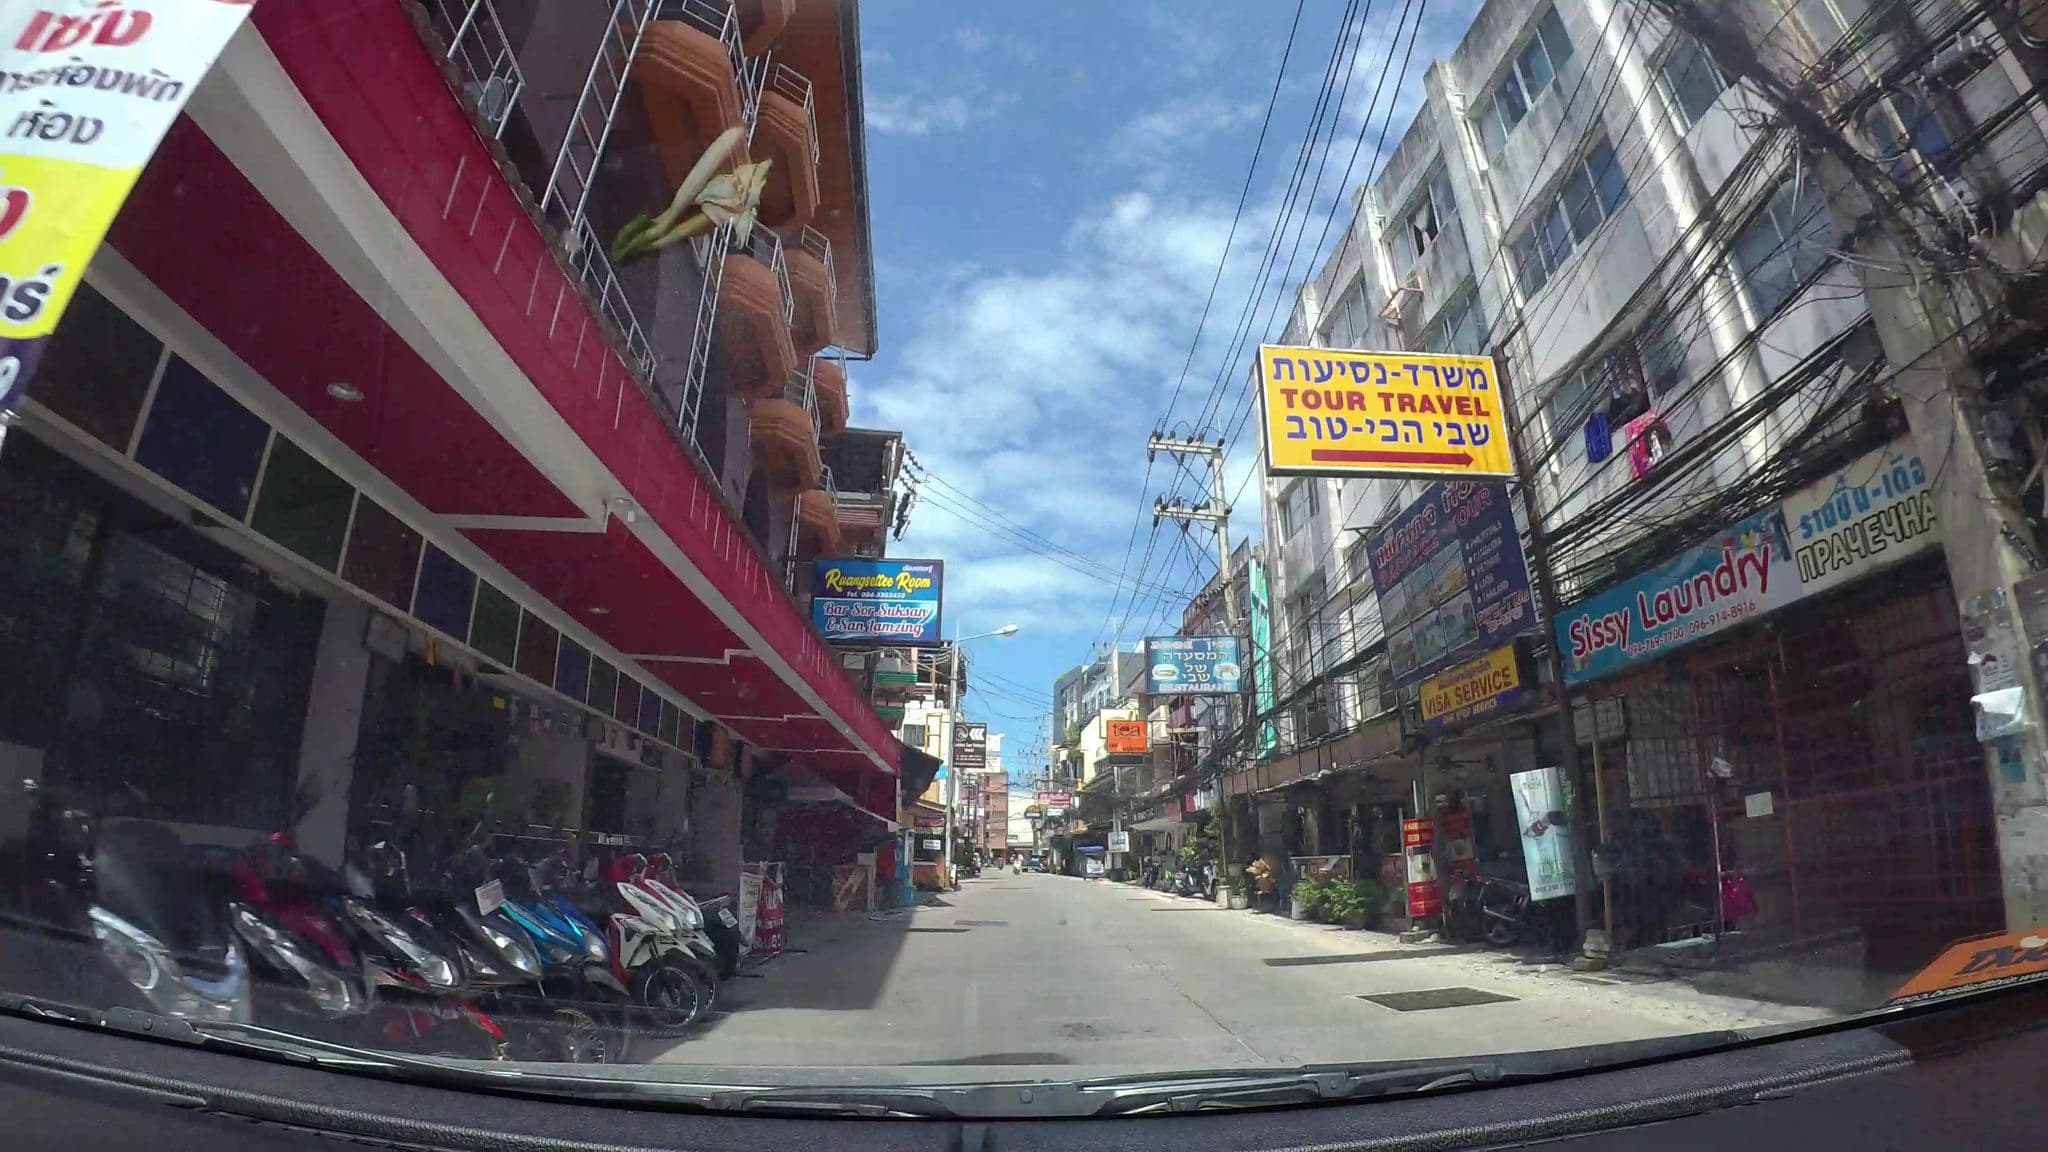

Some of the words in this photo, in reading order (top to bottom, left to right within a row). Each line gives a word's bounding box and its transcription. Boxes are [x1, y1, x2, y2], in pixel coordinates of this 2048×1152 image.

[1272, 357, 1489, 391] משרד-נסיעות
[1280, 388, 1366, 411] TOUR
[1377, 392, 1490, 417] TRAVEL
[1434, 421, 1490, 446] שבי
[896, 572, 931, 593] Room
[823, 601, 849, 616] Bar
[1569, 606, 1630, 657] Sissy
[1638, 542, 1774, 632] Laundry
[1425, 693, 1451, 717] VISA
[1454, 666, 1513, 702] SERVICE
